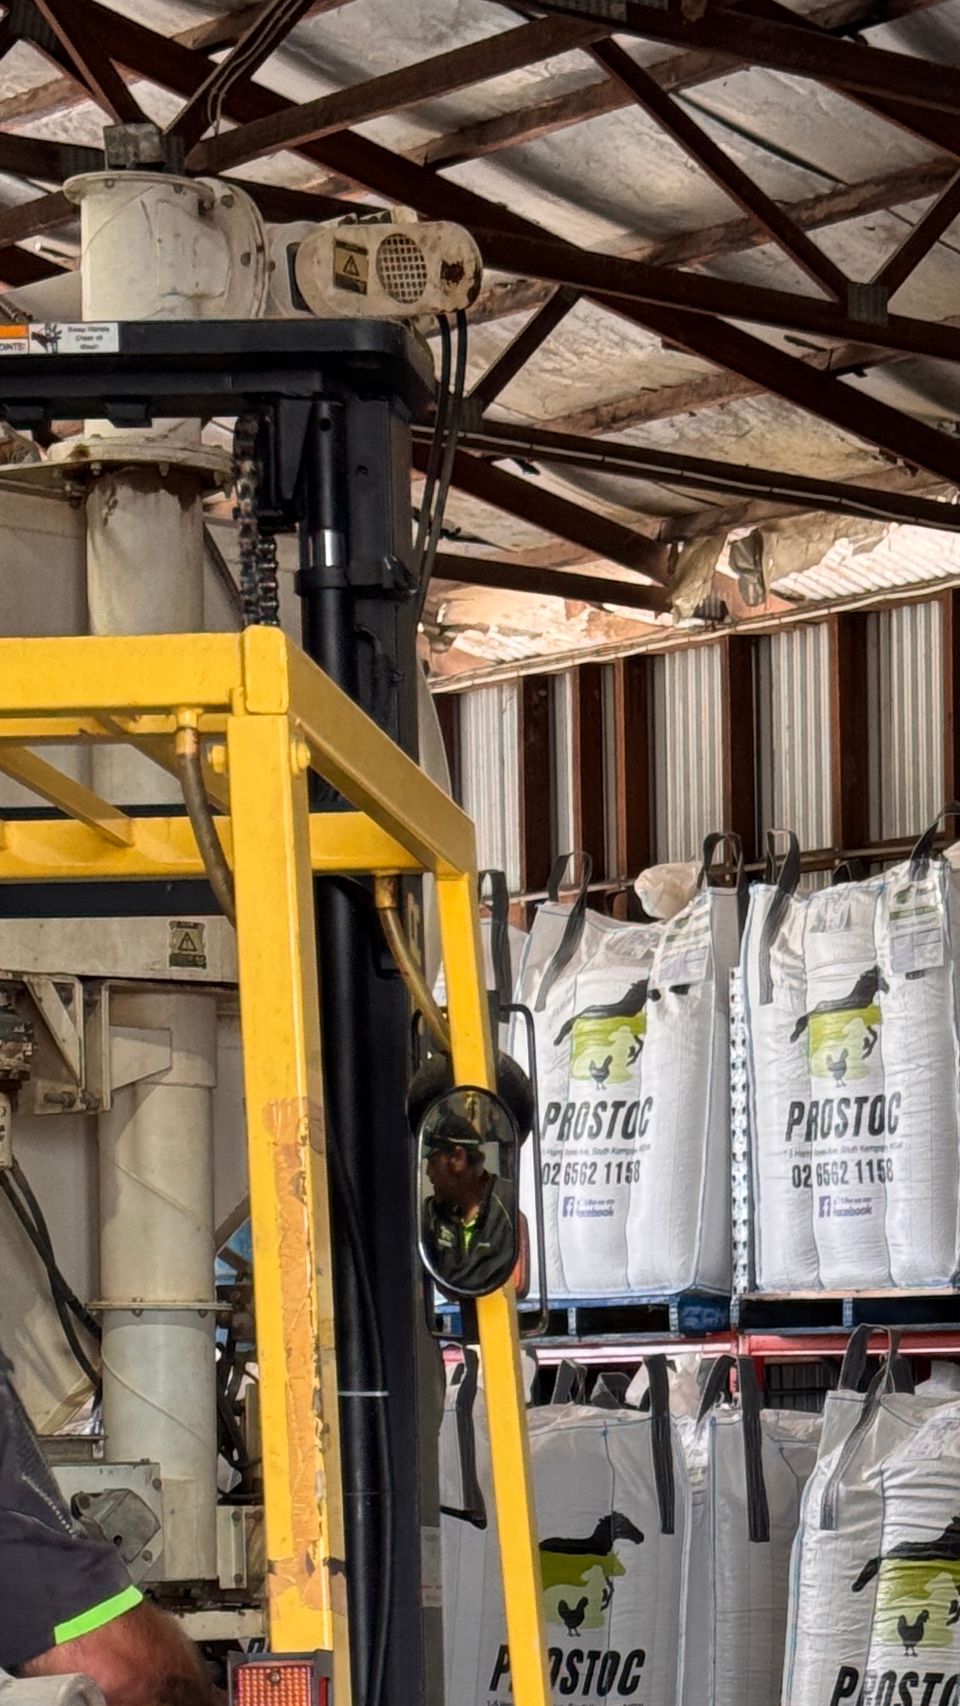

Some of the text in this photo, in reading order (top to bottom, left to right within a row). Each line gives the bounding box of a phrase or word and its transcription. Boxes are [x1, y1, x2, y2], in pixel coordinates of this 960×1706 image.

[540, 1096, 653, 1141] PROSTOC
[785, 1092, 902, 1142] PROSTOC
[542, 1160, 641, 1185] 02 6562 1158
[792, 1158, 894, 1188] 02 6562 1158
[489, 1644, 646, 1696] POSTOC
